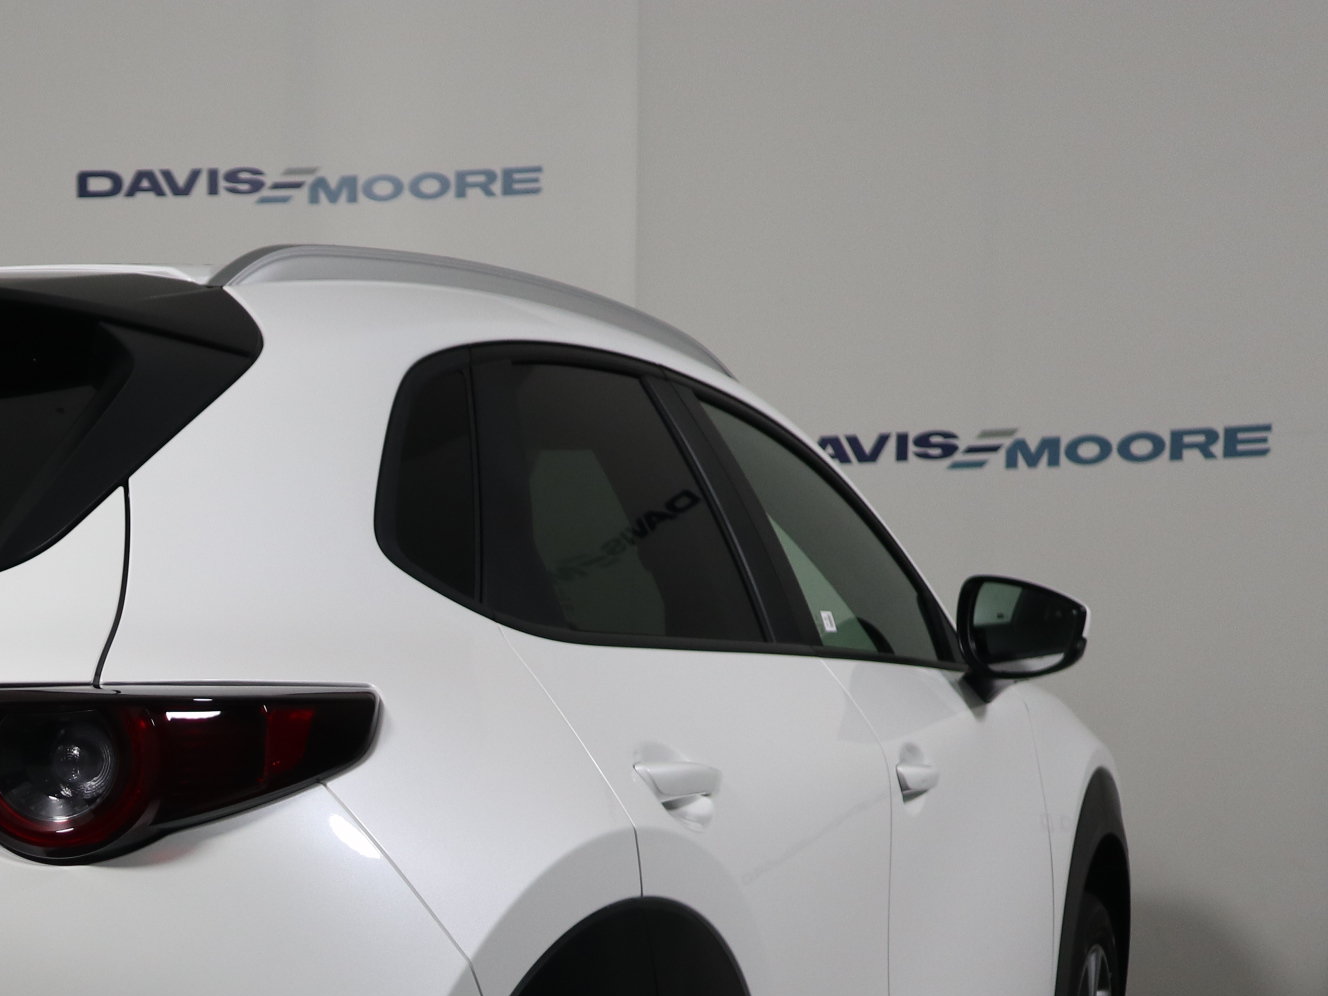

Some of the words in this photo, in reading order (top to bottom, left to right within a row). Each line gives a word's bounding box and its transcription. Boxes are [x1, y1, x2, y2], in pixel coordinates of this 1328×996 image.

[76, 167, 266, 198] DAVIS
[307, 166, 543, 204] MOORE
[816, 429, 960, 465] AVIS
[1005, 423, 1272, 469] MOORE
